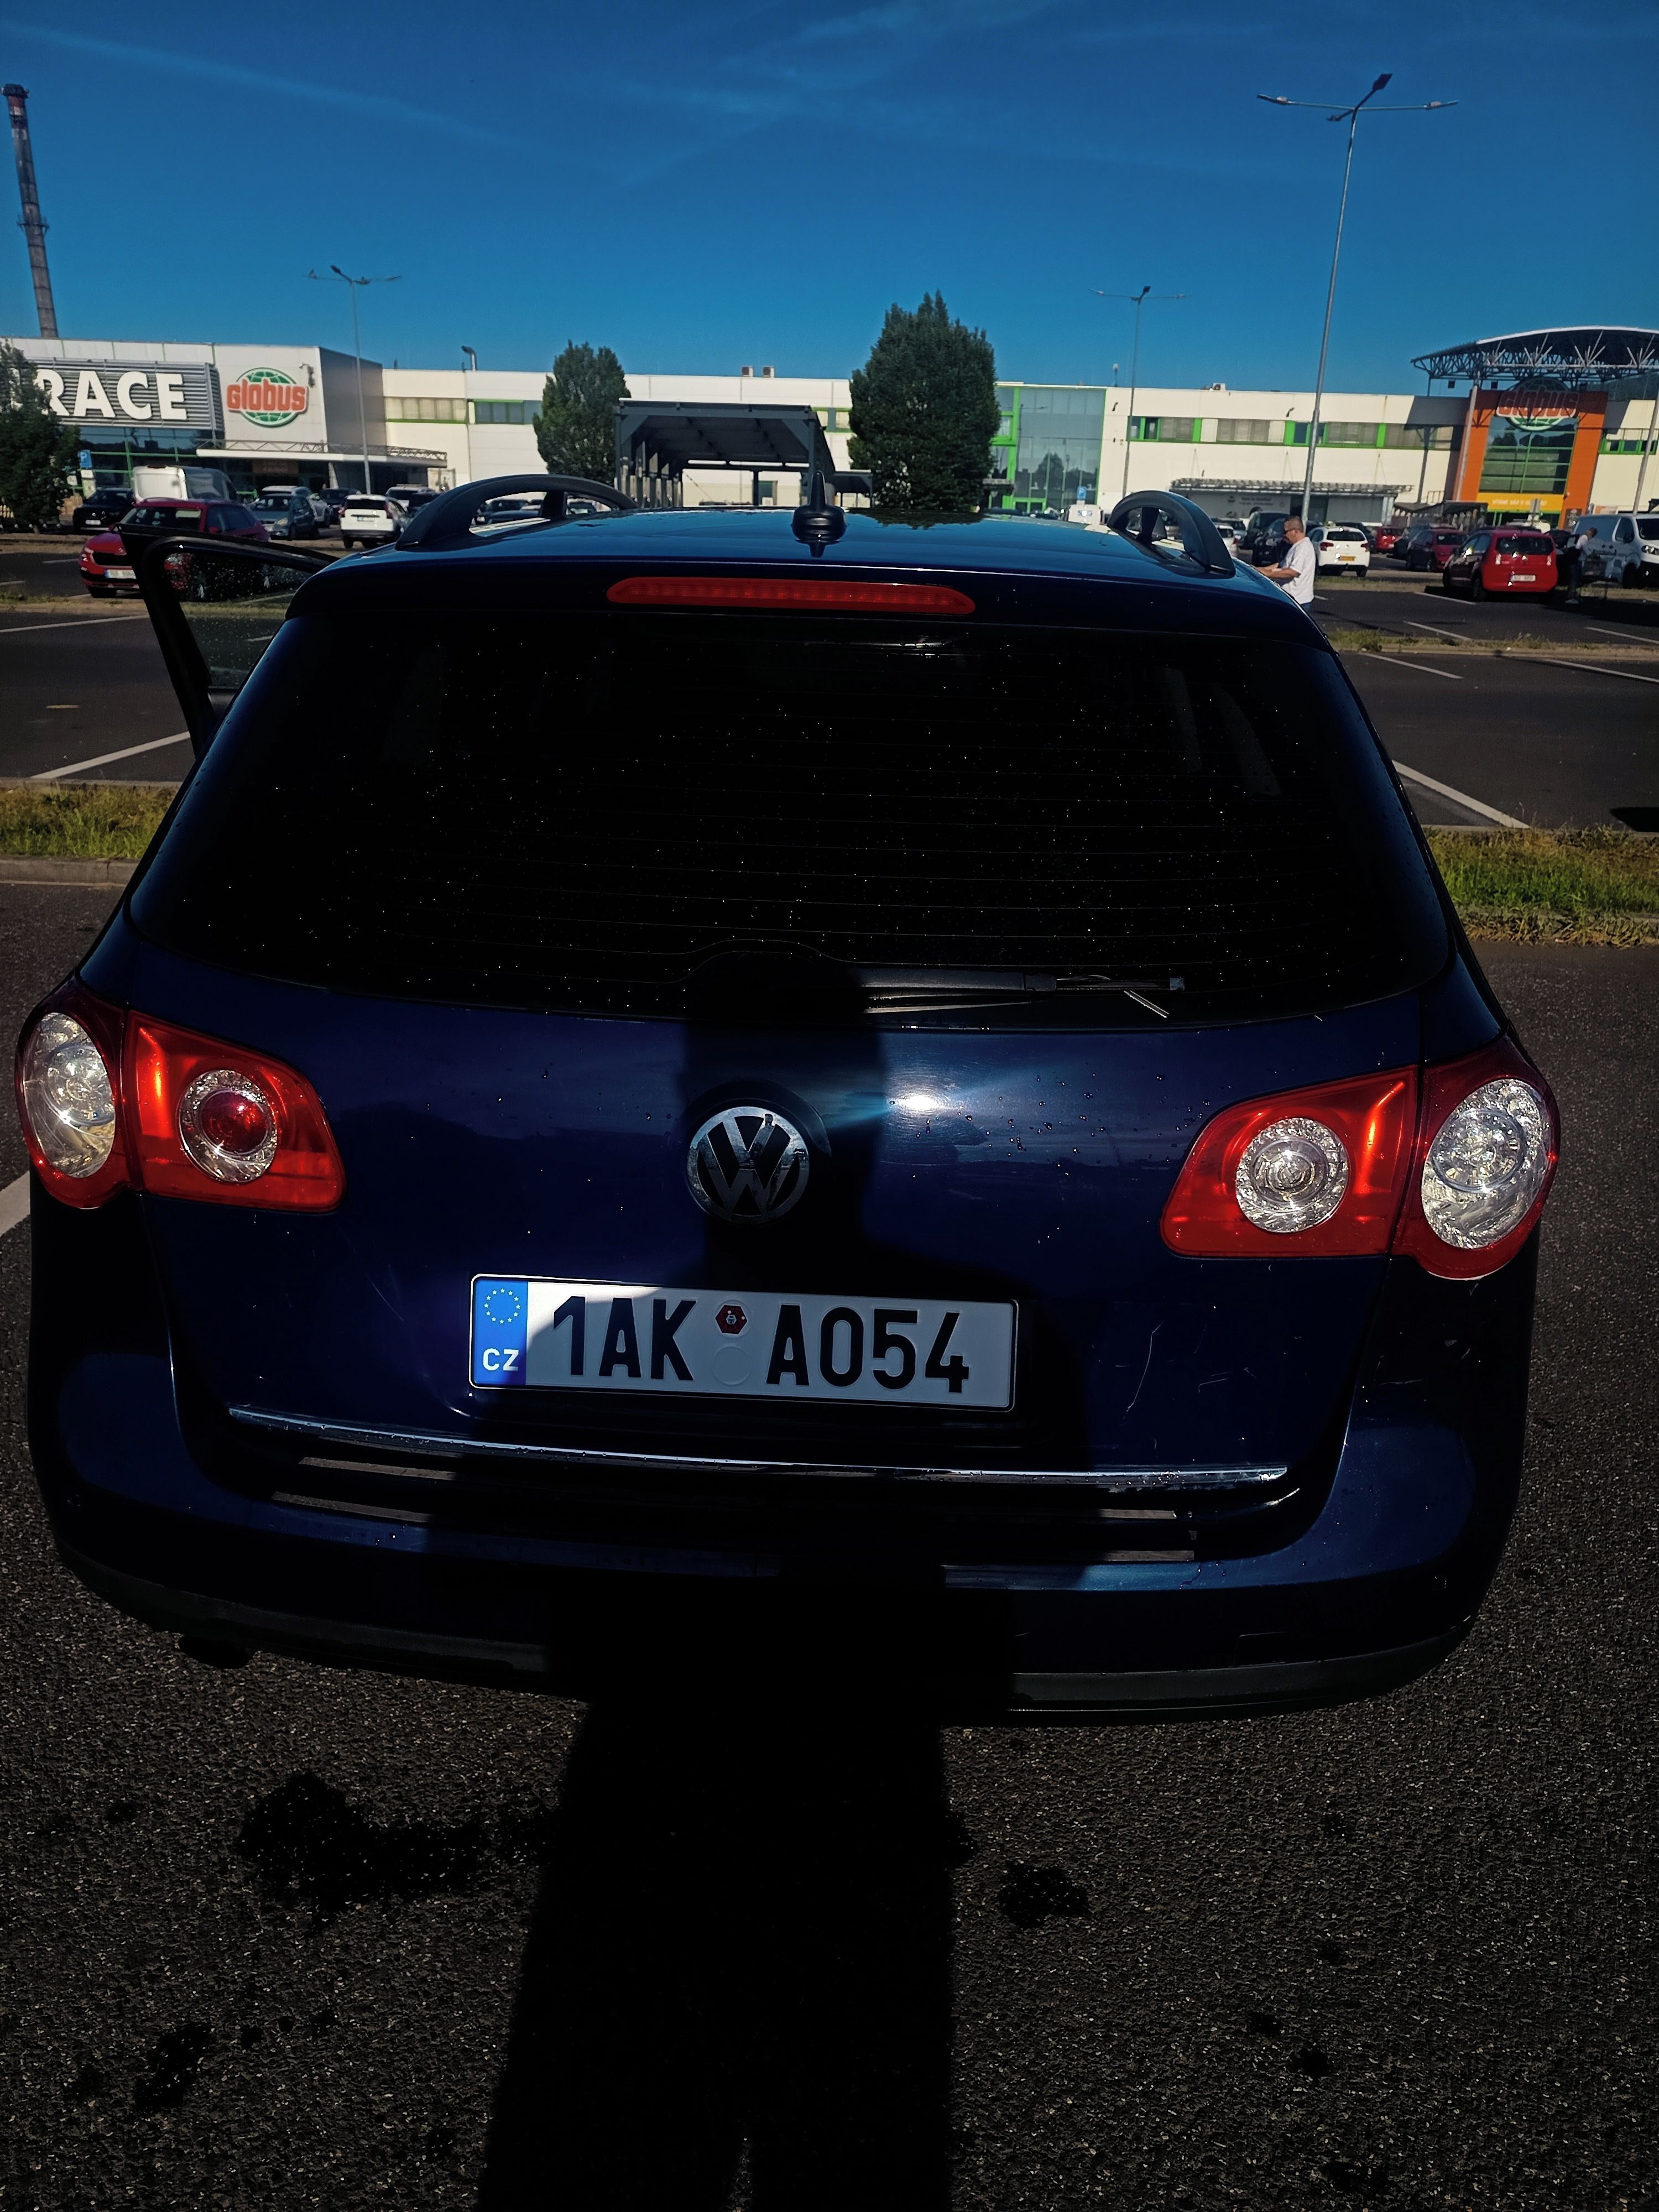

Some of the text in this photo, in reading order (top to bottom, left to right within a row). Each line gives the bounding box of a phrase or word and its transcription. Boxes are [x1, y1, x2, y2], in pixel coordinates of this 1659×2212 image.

[8, 368, 187, 420] RACE
[227, 378, 306, 411] Globus
[554, 1296, 697, 1381] 1AK
[482, 1348, 520, 1372] CZ
